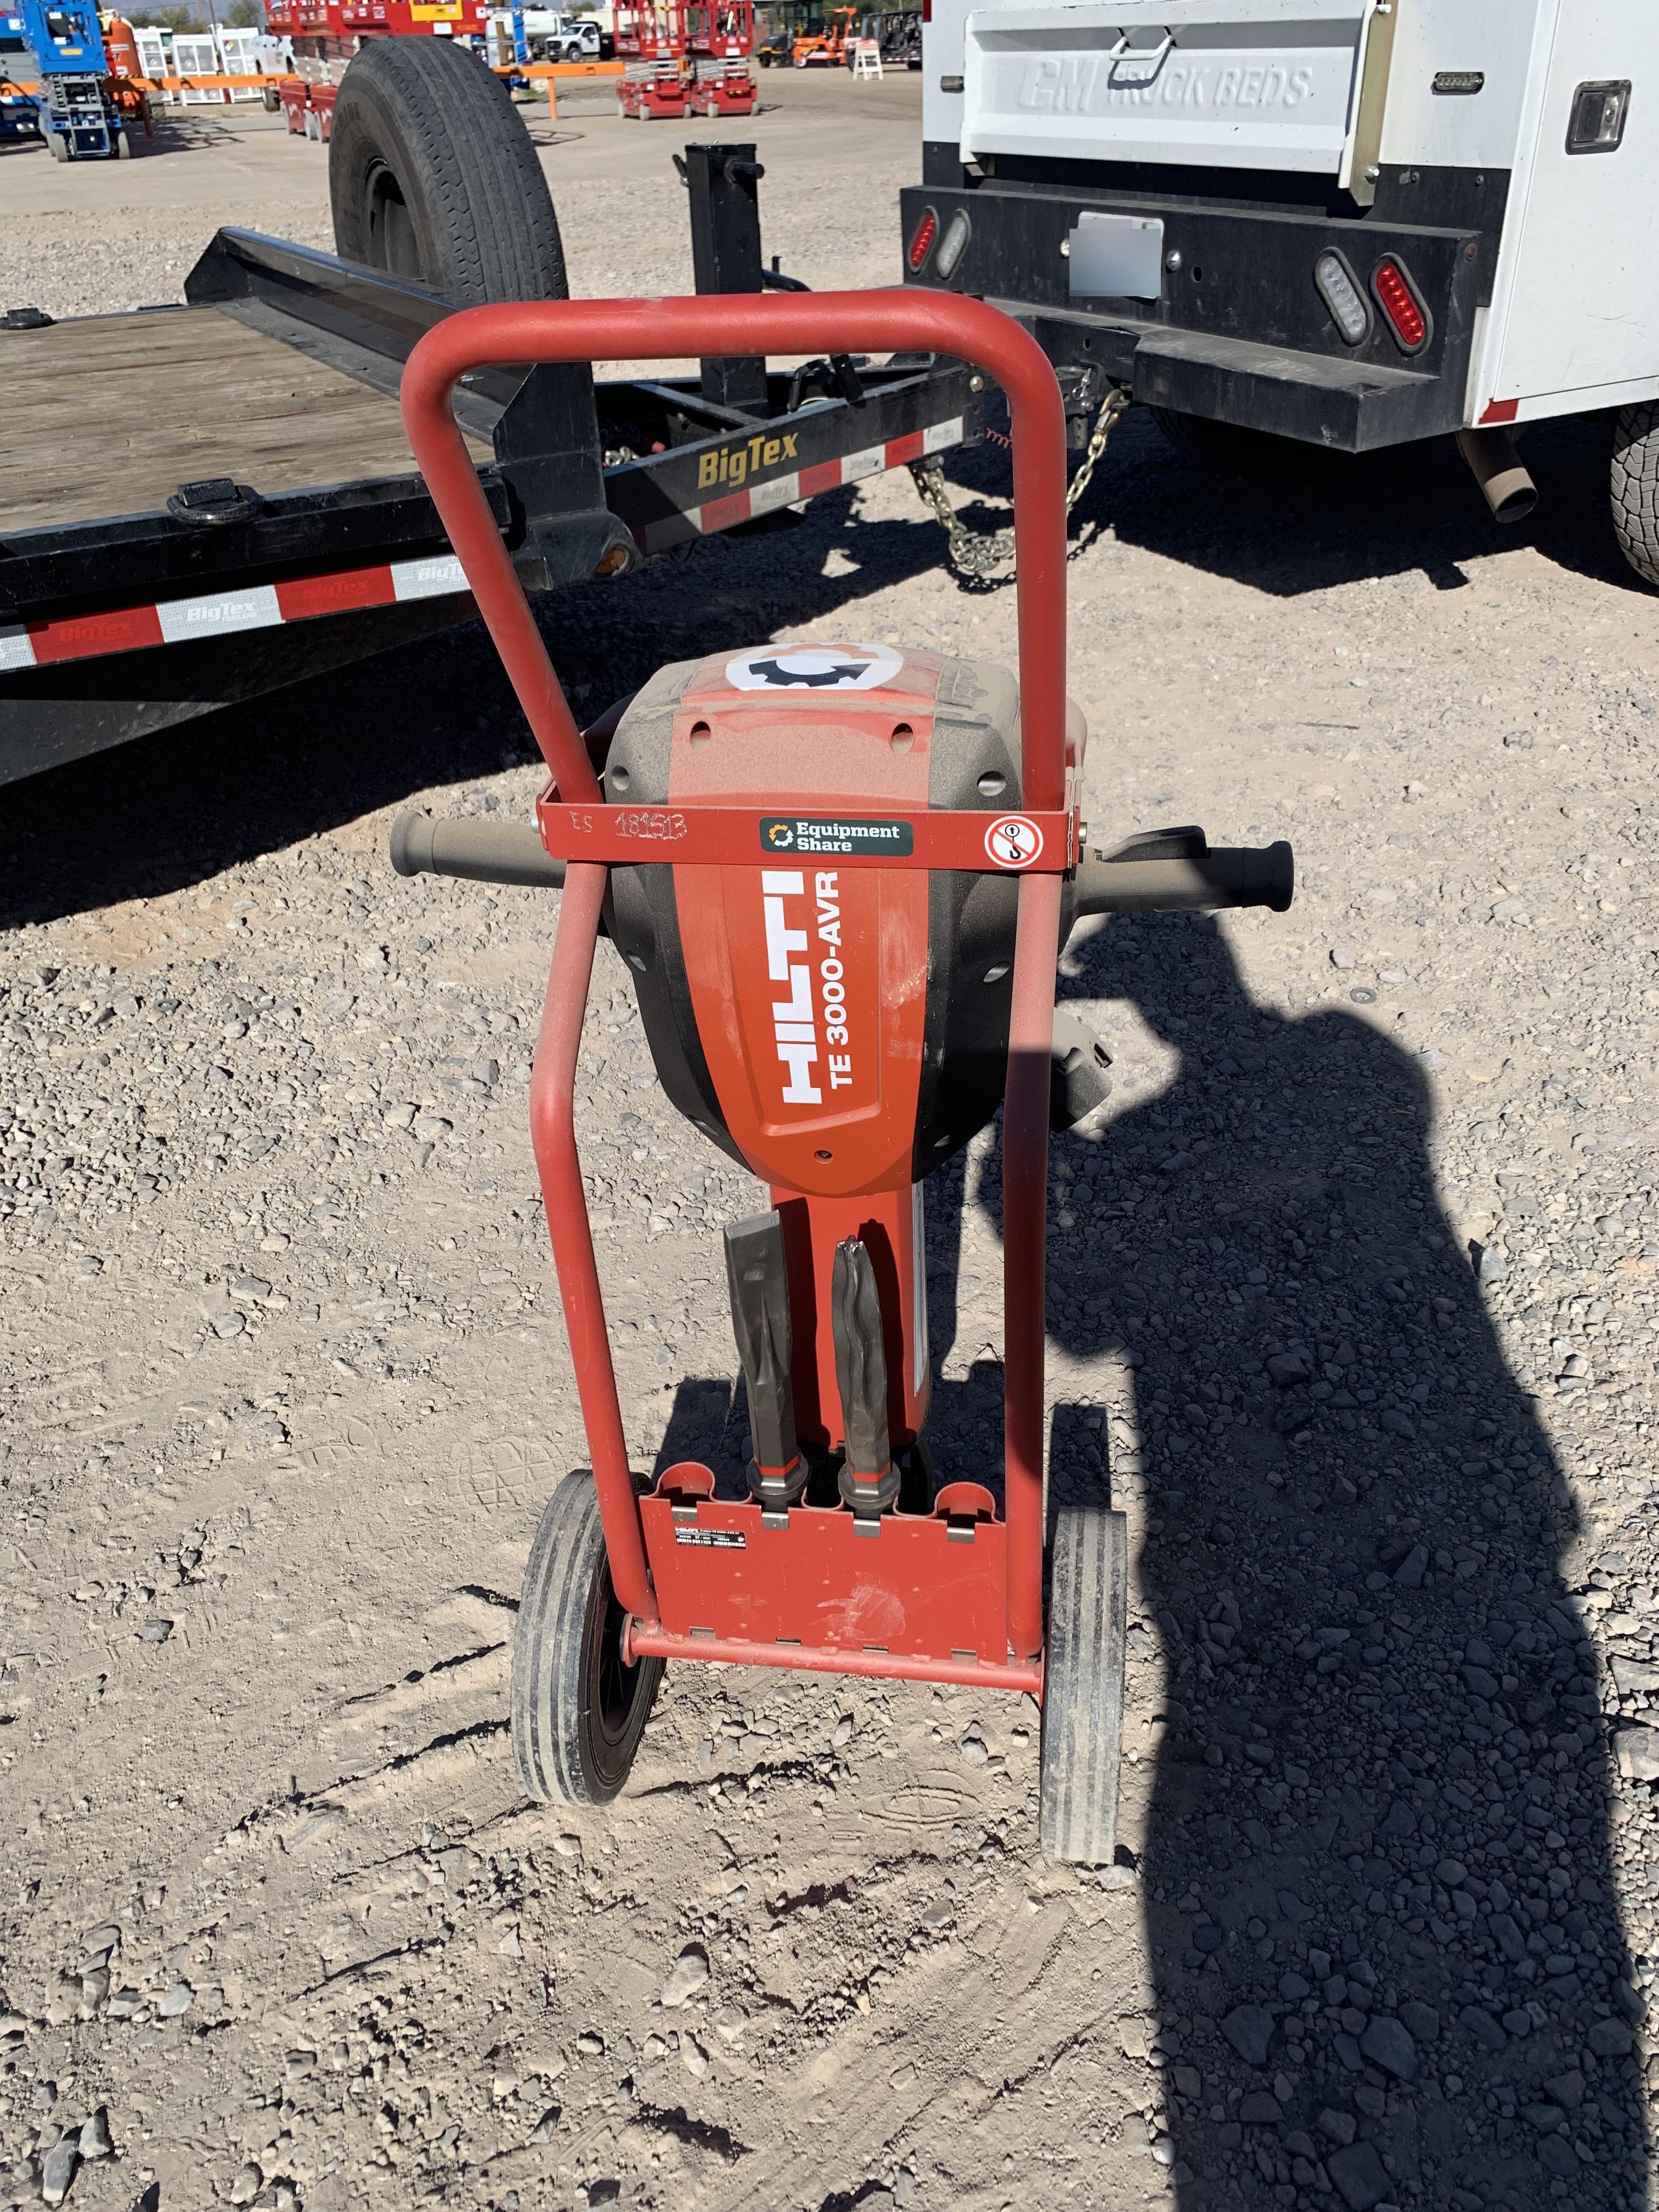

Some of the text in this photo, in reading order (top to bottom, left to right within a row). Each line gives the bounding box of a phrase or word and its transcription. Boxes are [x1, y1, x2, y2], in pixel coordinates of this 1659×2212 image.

[1019, 59, 1314, 111] CM TRUCK BEDS
[697, 433, 799, 489] BigTex
[187, 602, 256, 622] BigTex
[569, 811, 593, 833] ES
[796, 821, 900, 839] Equipment
[798, 837, 853, 852] Share
[761, 870, 823, 1104] HILTI
[815, 871, 853, 1090] TE 3000-AVR
